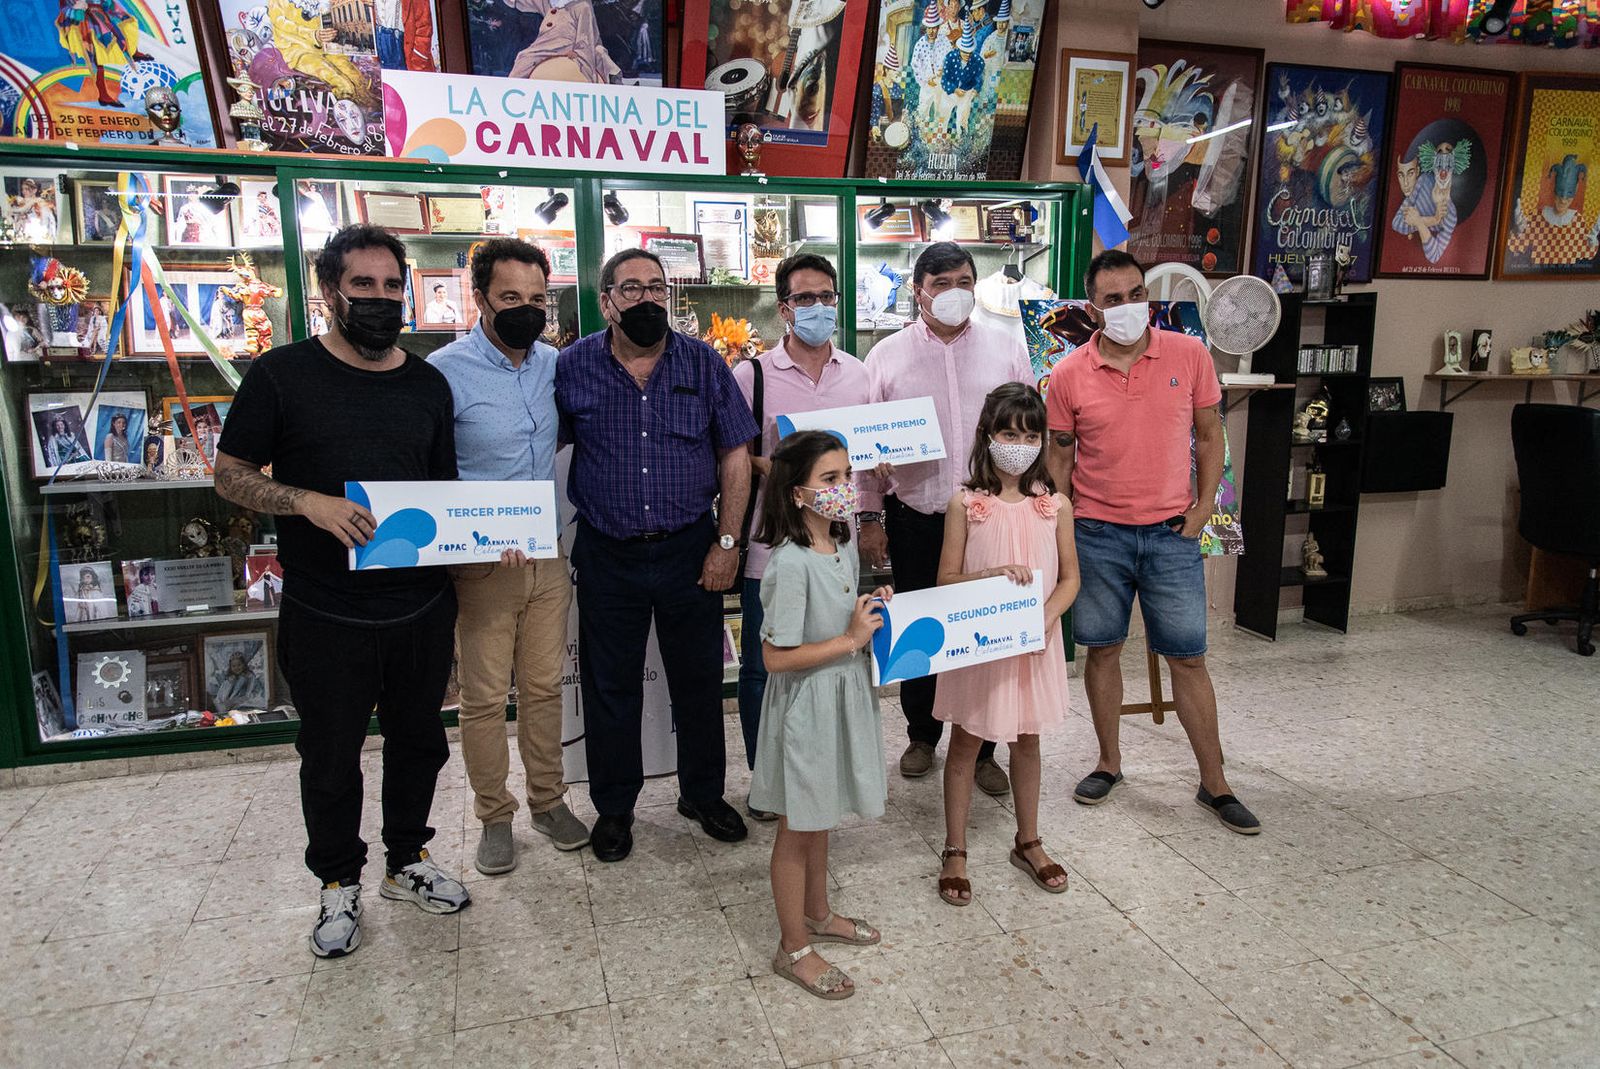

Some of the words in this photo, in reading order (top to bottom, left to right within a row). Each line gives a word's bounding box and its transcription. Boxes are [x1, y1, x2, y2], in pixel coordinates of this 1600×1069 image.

[1404, 74, 1450, 92] CARNAVAL
[1452, 78, 1505, 96] COLOMBINO
[253, 87, 338, 115] HUELVA
[447, 85, 487, 116] LA
[501, 88, 643, 125] CANTINA
[656, 98, 708, 129] DEL
[31, 113, 56, 123] DEL
[60, 114, 75, 124] 25
[78, 115, 95, 125] DE
[100, 115, 140, 127] ENERO
[1551, 116, 1592, 128] CARNAVAL
[55, 127, 73, 137] DE
[77, 128, 134, 140] FEBRERO
[276, 117, 297, 133] 27
[299, 120, 313, 136] de
[315, 122, 361, 156] Febrero
[362, 135, 376, 152] al
[1548, 127, 1593, 137] COLOMBINO
[475, 120, 710, 165] CARNAVAL
[928, 153, 957, 170] HUELVA
[1267, 188, 1372, 229] Carnaval
[1268, 253, 1311, 264] HUELV
[853, 423, 889, 434] PRIMER
[891, 418, 927, 429] PREMIO
[851, 453, 874, 461] FOPAC
[446, 507, 494, 518] TERCER
[497, 506, 542, 516] PREMIO
[438, 543, 467, 552] FOPAC
[947, 605, 997, 623] SEGUNDO
[1000, 597, 1037, 613] PREMIO
[946, 646, 970, 658] FOPAC
